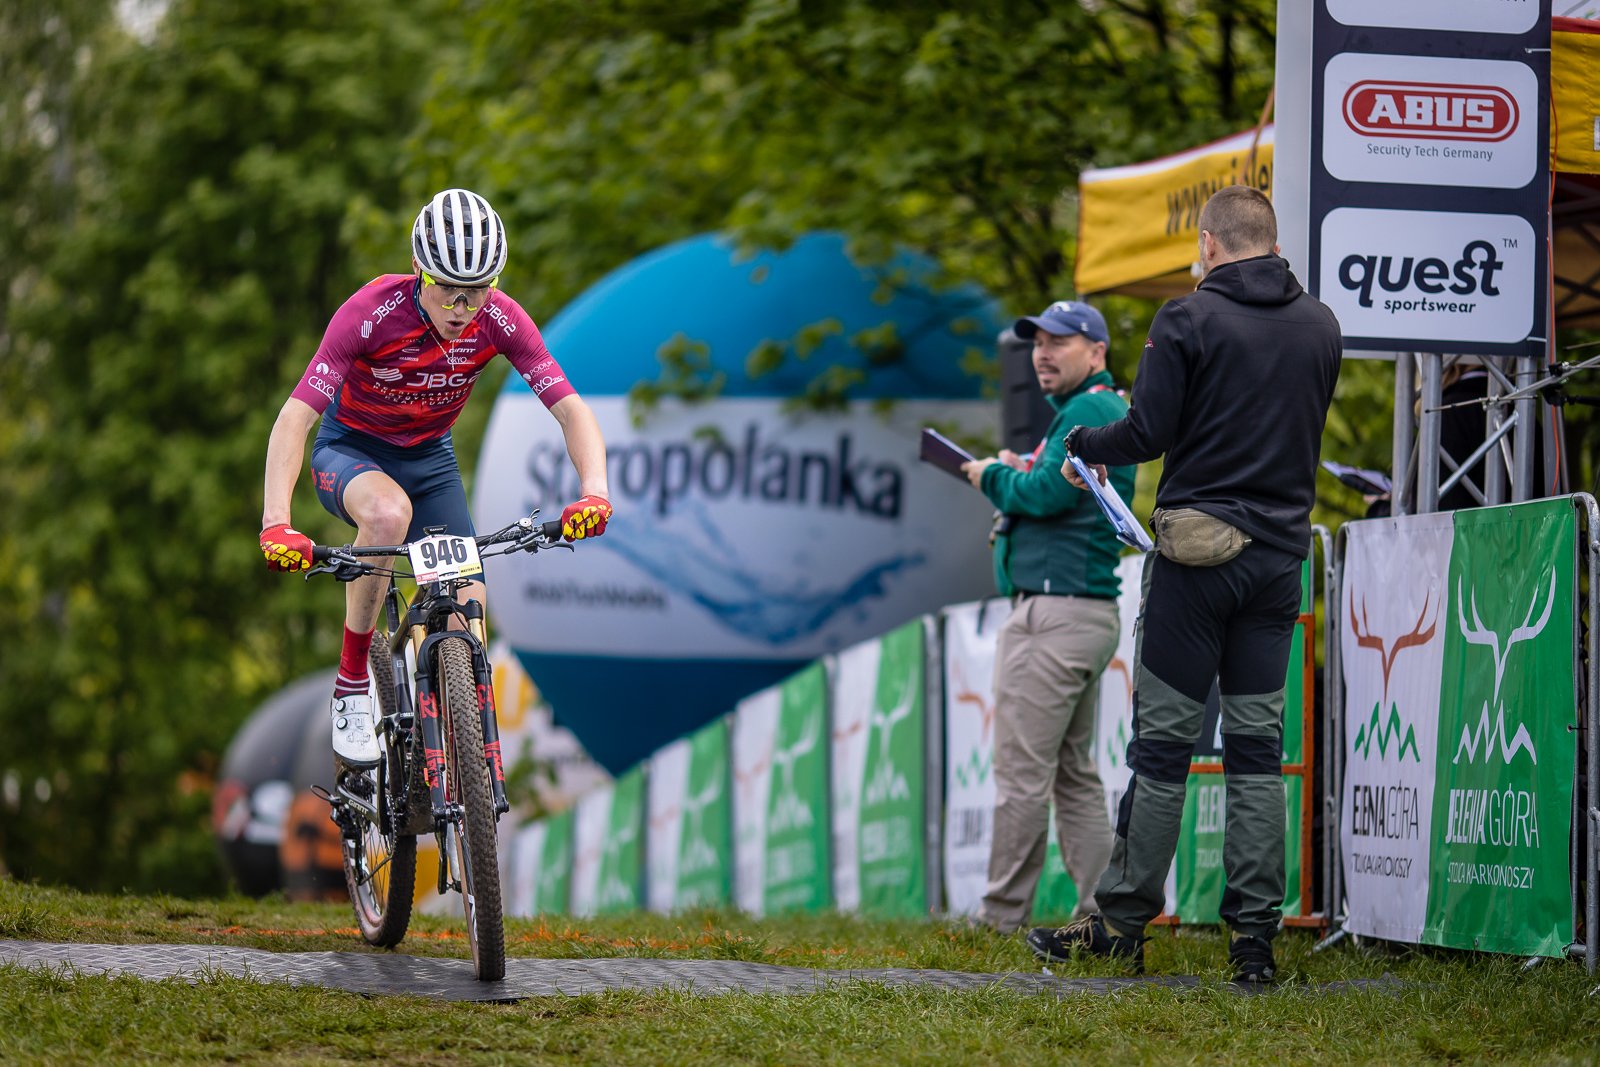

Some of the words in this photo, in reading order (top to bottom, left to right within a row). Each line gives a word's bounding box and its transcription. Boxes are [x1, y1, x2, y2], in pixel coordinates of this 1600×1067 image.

[1367, 93, 1495, 129] ABUS
[1367, 143, 1411, 157] Security
[1414, 144, 1439, 157] Tech
[1443, 146, 1493, 161] Germany
[1338, 240, 1503, 308] quest
[372, 290, 406, 325] JBG2
[483, 303, 517, 337] JBG2
[1384, 297, 1476, 314] sportswear
[308, 375, 335, 398] CRYO
[420, 538, 468, 569] 946
[1489, 783, 1540, 848] GÓRA
[1466, 863, 1535, 889] KARKONOSZY
